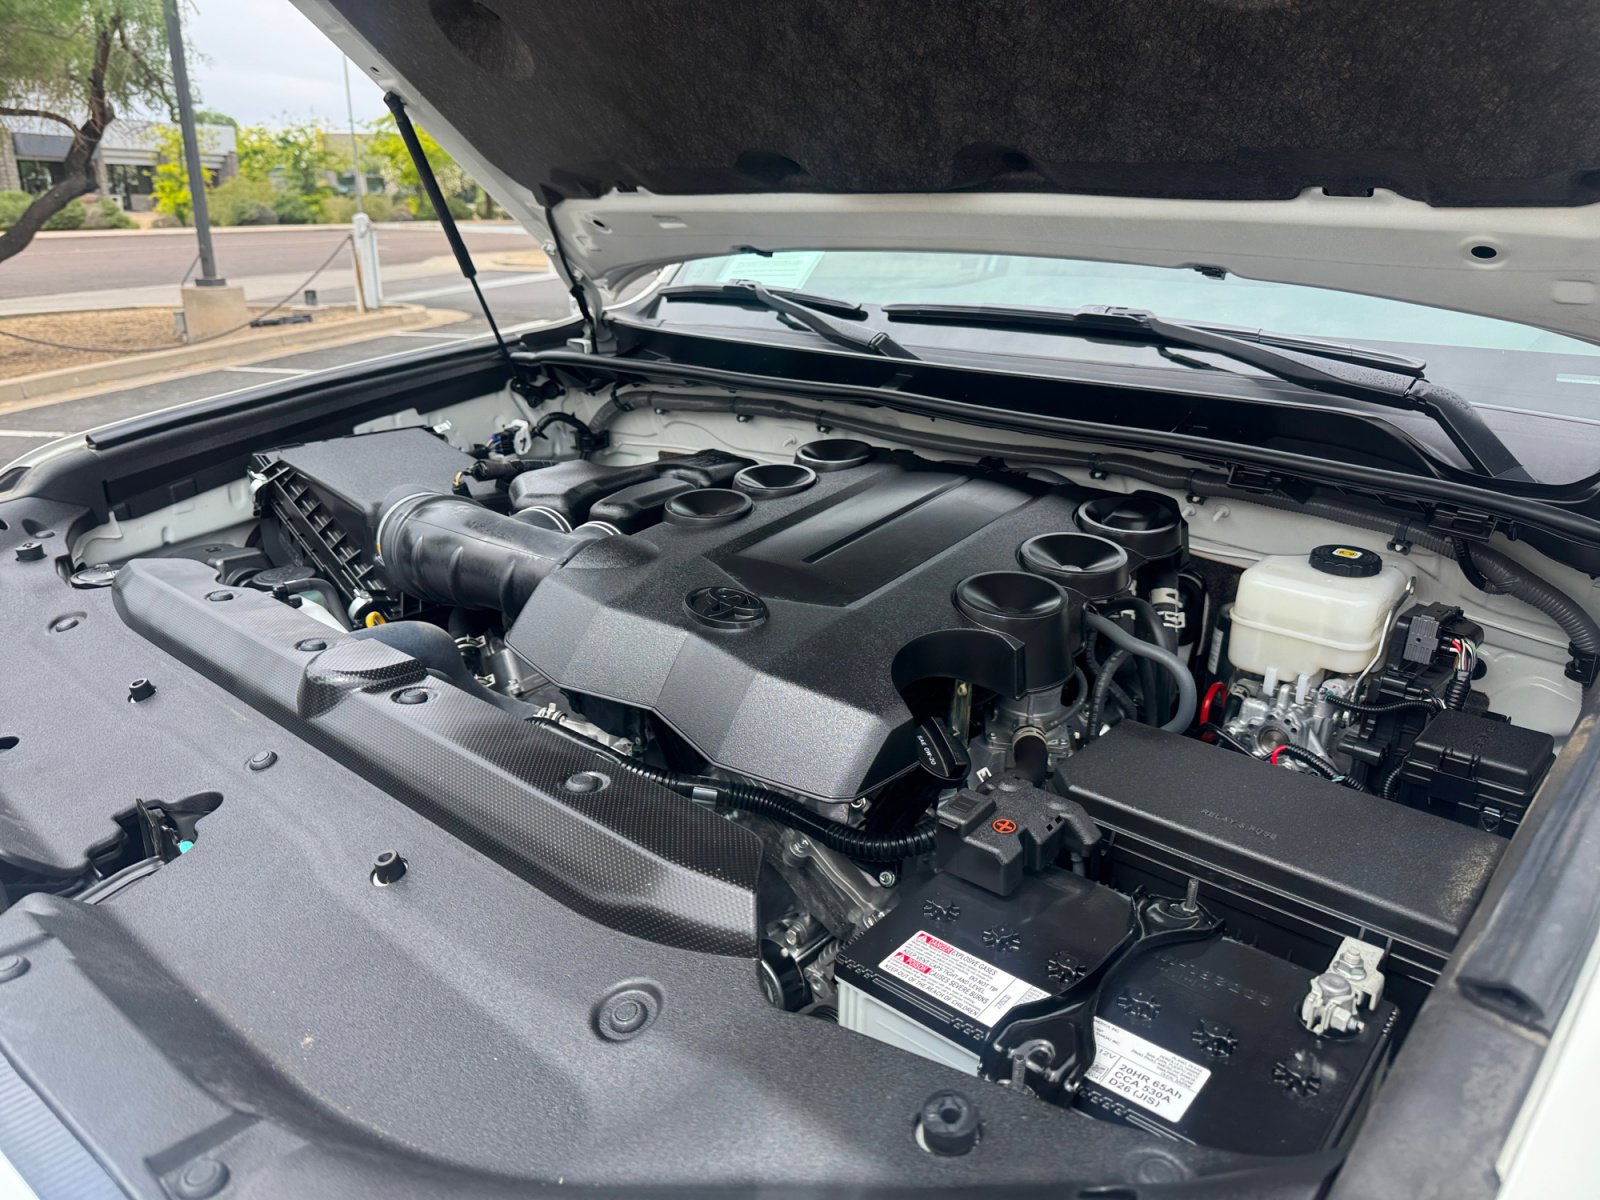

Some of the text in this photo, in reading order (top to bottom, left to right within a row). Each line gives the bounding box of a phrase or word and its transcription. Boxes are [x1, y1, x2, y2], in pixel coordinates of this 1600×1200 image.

[902, 948, 987, 994] KEEP VENT CAPS TIGHT AND LEVEL
[926, 938, 999, 975] DANGER EXPLOSIVE GASES
[883, 963, 898, 973] KEEP
[896, 970, 909, 978] OUT
[914, 980, 927, 988] THE
[924, 985, 944, 997] REACH
[950, 999, 979, 1016] CHILDREN
[904, 957, 928, 972] POISON
[928, 970, 951, 983] CAUSES
[947, 980, 971, 994] SEVERE
[967, 991, 990, 1003] BURNS
[1097, 1048, 1116, 1059] 12V
[1107, 1077, 1161, 1107] D26 (JIS)
[1112, 1070, 1140, 1088] CCA
[1141, 1084, 1172, 1103] 530A
[1117, 1063, 1151, 1083] 20HR
[1151, 1079, 1183, 1099] 65Ah
